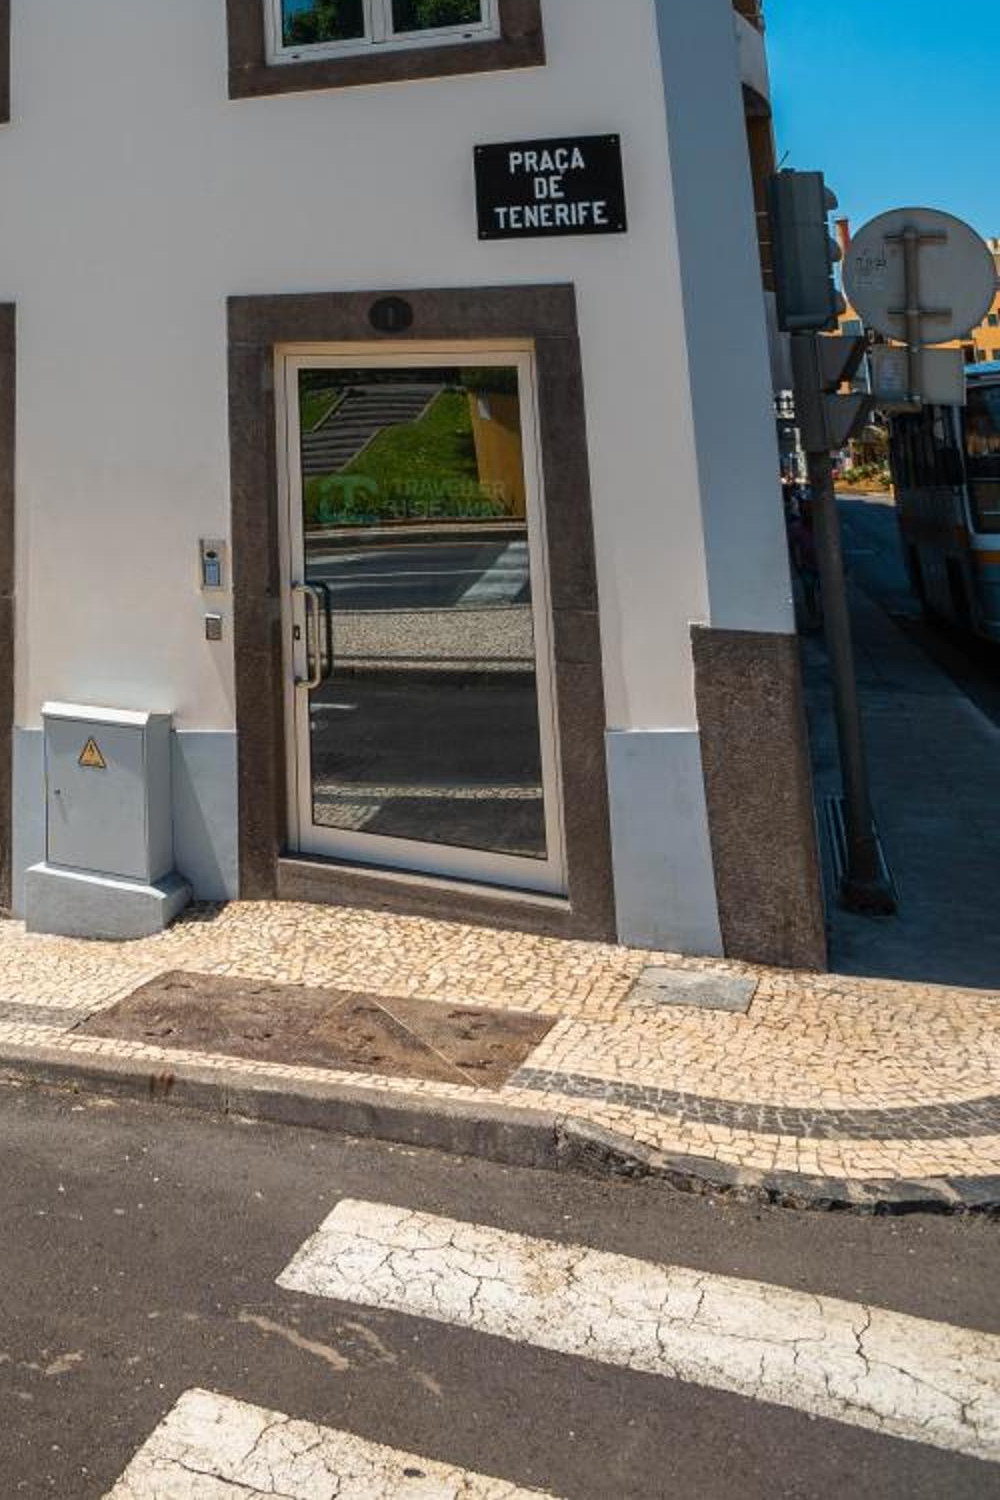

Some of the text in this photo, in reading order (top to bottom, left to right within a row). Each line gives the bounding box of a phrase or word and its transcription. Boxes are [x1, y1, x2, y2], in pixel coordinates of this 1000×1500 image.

[509, 147, 585, 175] PRAÇA
[534, 175, 565, 199] DE
[494, 201, 608, 229] TENERIFE
